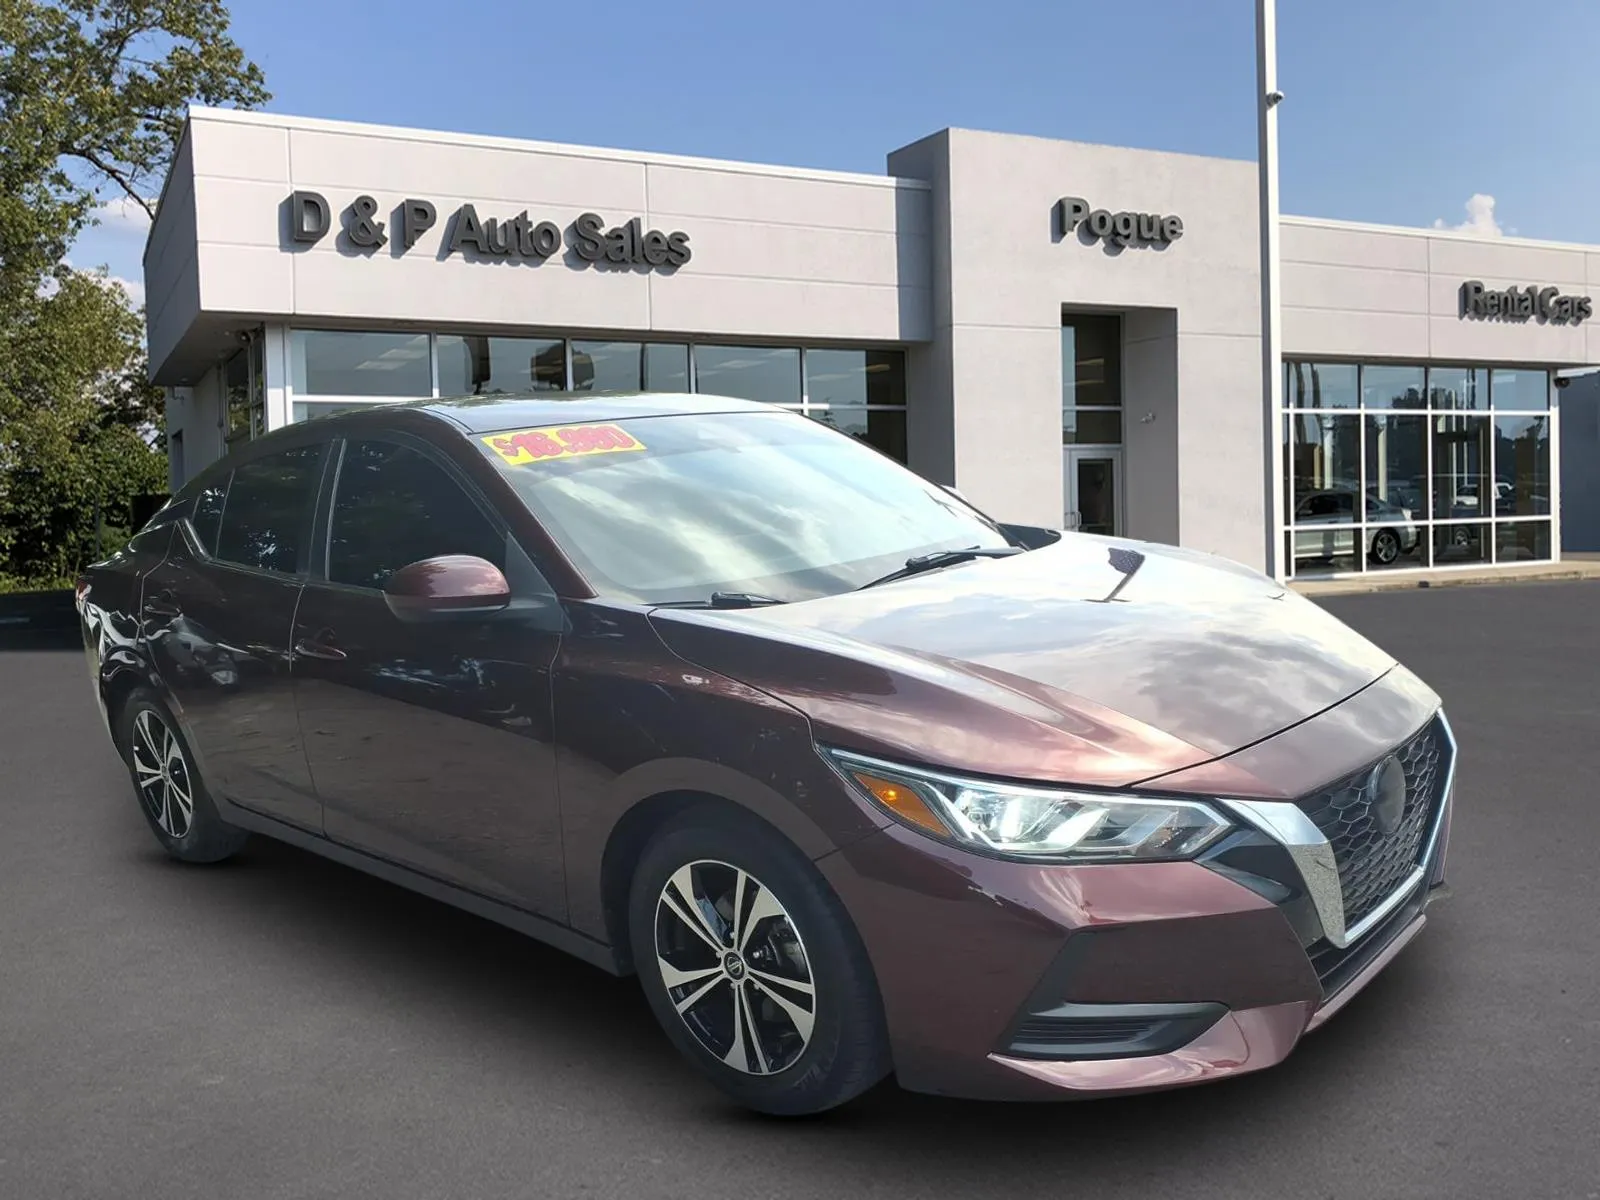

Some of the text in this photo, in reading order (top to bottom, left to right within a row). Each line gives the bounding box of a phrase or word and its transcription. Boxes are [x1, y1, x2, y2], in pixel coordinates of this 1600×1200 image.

[280, 190, 692, 275] D & P Auto Sales
[1052, 197, 1184, 255] Pogue
[1459, 280, 1592, 325] Rental Cars
